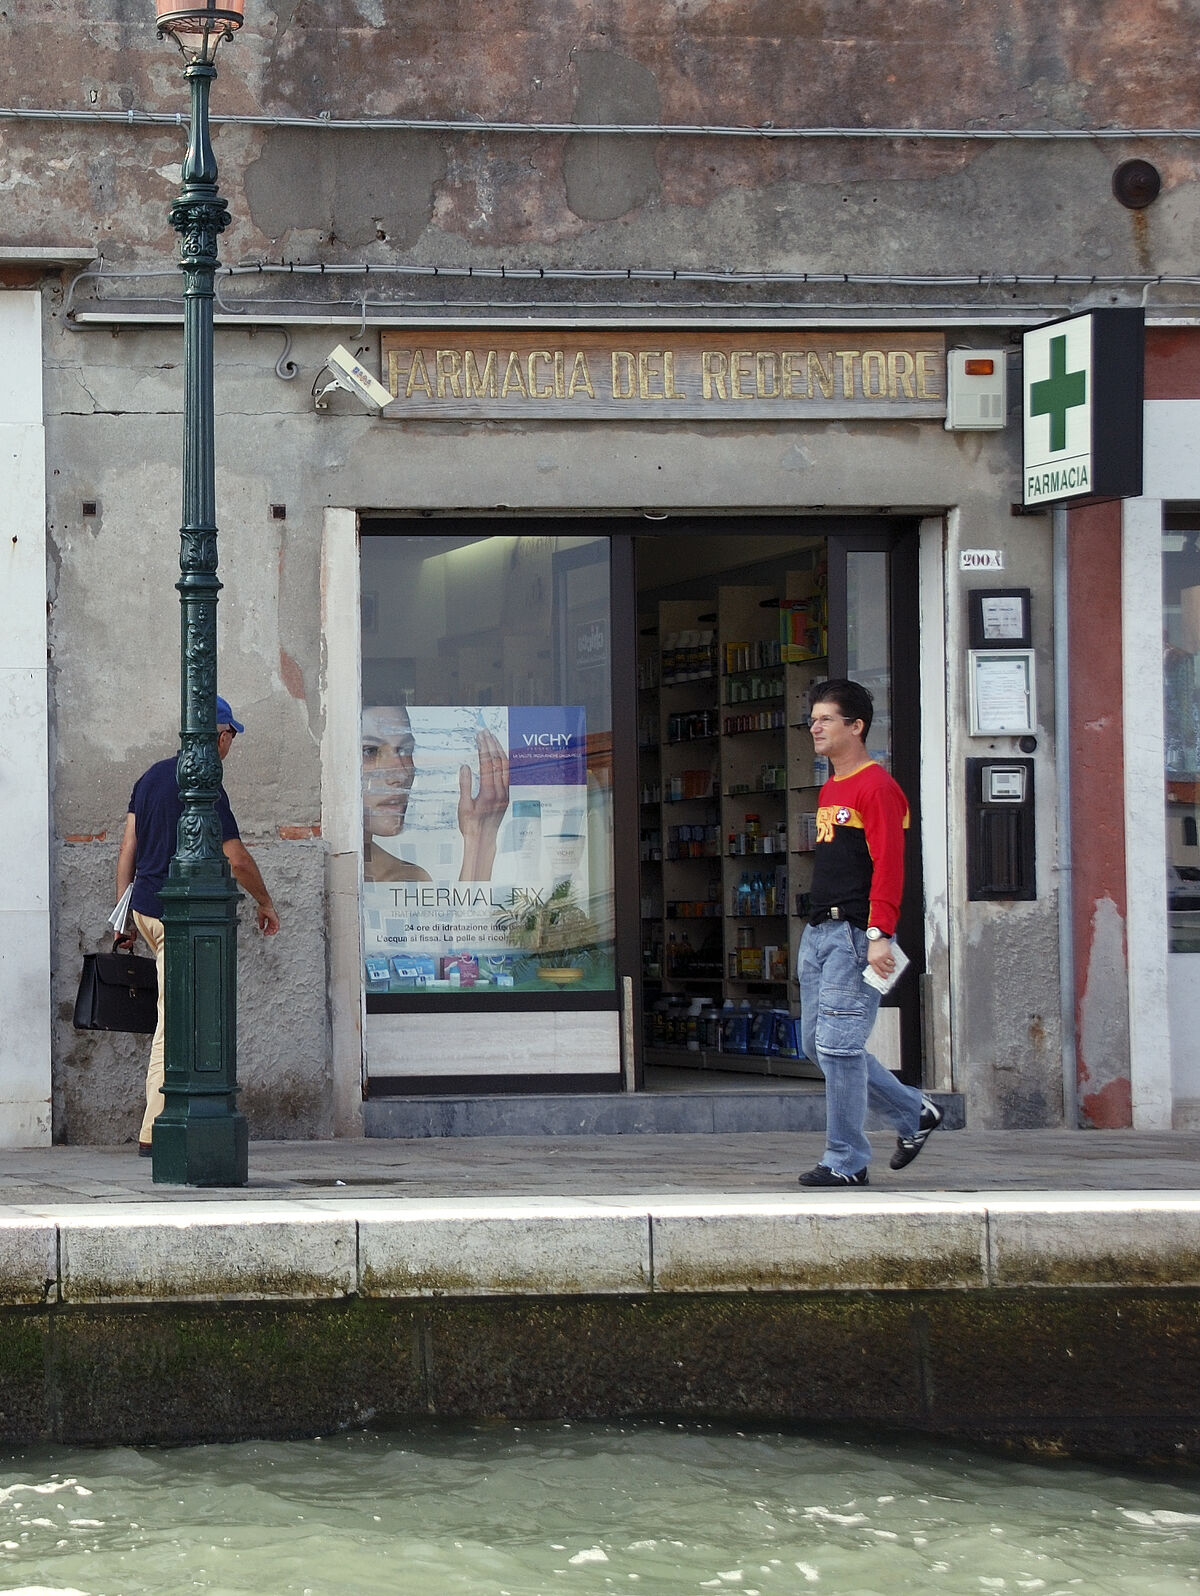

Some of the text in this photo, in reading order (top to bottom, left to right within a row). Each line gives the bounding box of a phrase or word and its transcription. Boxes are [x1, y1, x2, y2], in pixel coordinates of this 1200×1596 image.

[387, 349, 597, 399] FARMACIA
[611, 350, 687, 400] DEL
[702, 350, 942, 400] REDENTORE
[1027, 464, 1088, 498] FARMACIA
[522, 733, 572, 746] VICHY
[389, 887, 502, 907] THERMAL
[404, 924, 414, 932] 24
[432, 924, 440, 932] di
[442, 924, 488, 932] idratazione
[376, 935, 408, 943] L'acqua
[456, 935, 476, 943] pelle
[478, 934, 485, 942] si
